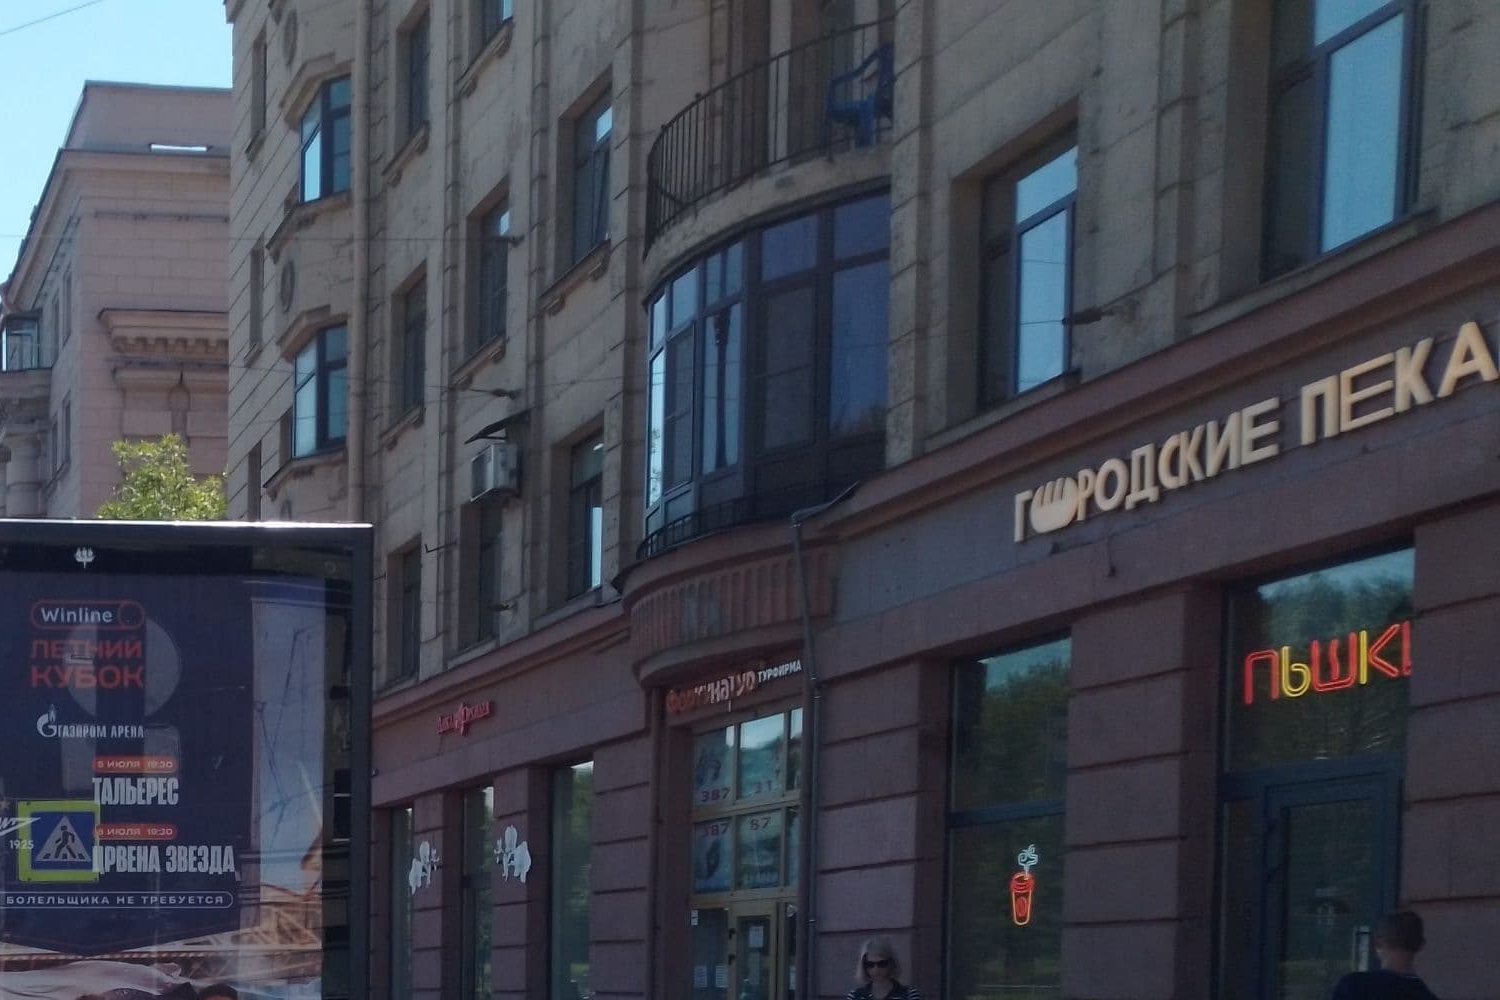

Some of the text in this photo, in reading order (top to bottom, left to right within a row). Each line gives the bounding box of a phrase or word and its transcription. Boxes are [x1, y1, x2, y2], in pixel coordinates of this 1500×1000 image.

[1014, 397, 1280, 543] ГОРОДСКИЕ
[41, 607, 113, 622] Winline
[31, 636, 142, 659] ЛЕТНИЙ
[31, 664, 144, 689] КУБОК
[758, 659, 803, 683] ТУРФИРМА
[57, 725, 145, 738] ГАЗПРОМ АРЕНА
[92, 777, 179, 805] ТАЛЬЕРЕС
[9, 840, 34, 850] 1925
[92, 845, 235, 875] ЦРВЕНА ЗВЕЗДА
[7, 896, 110, 906] БОЛЕЛЬЩИКА
[116, 896, 135, 904] НЕ
[142, 896, 224, 904] ТРЕБУЕТСЯ
